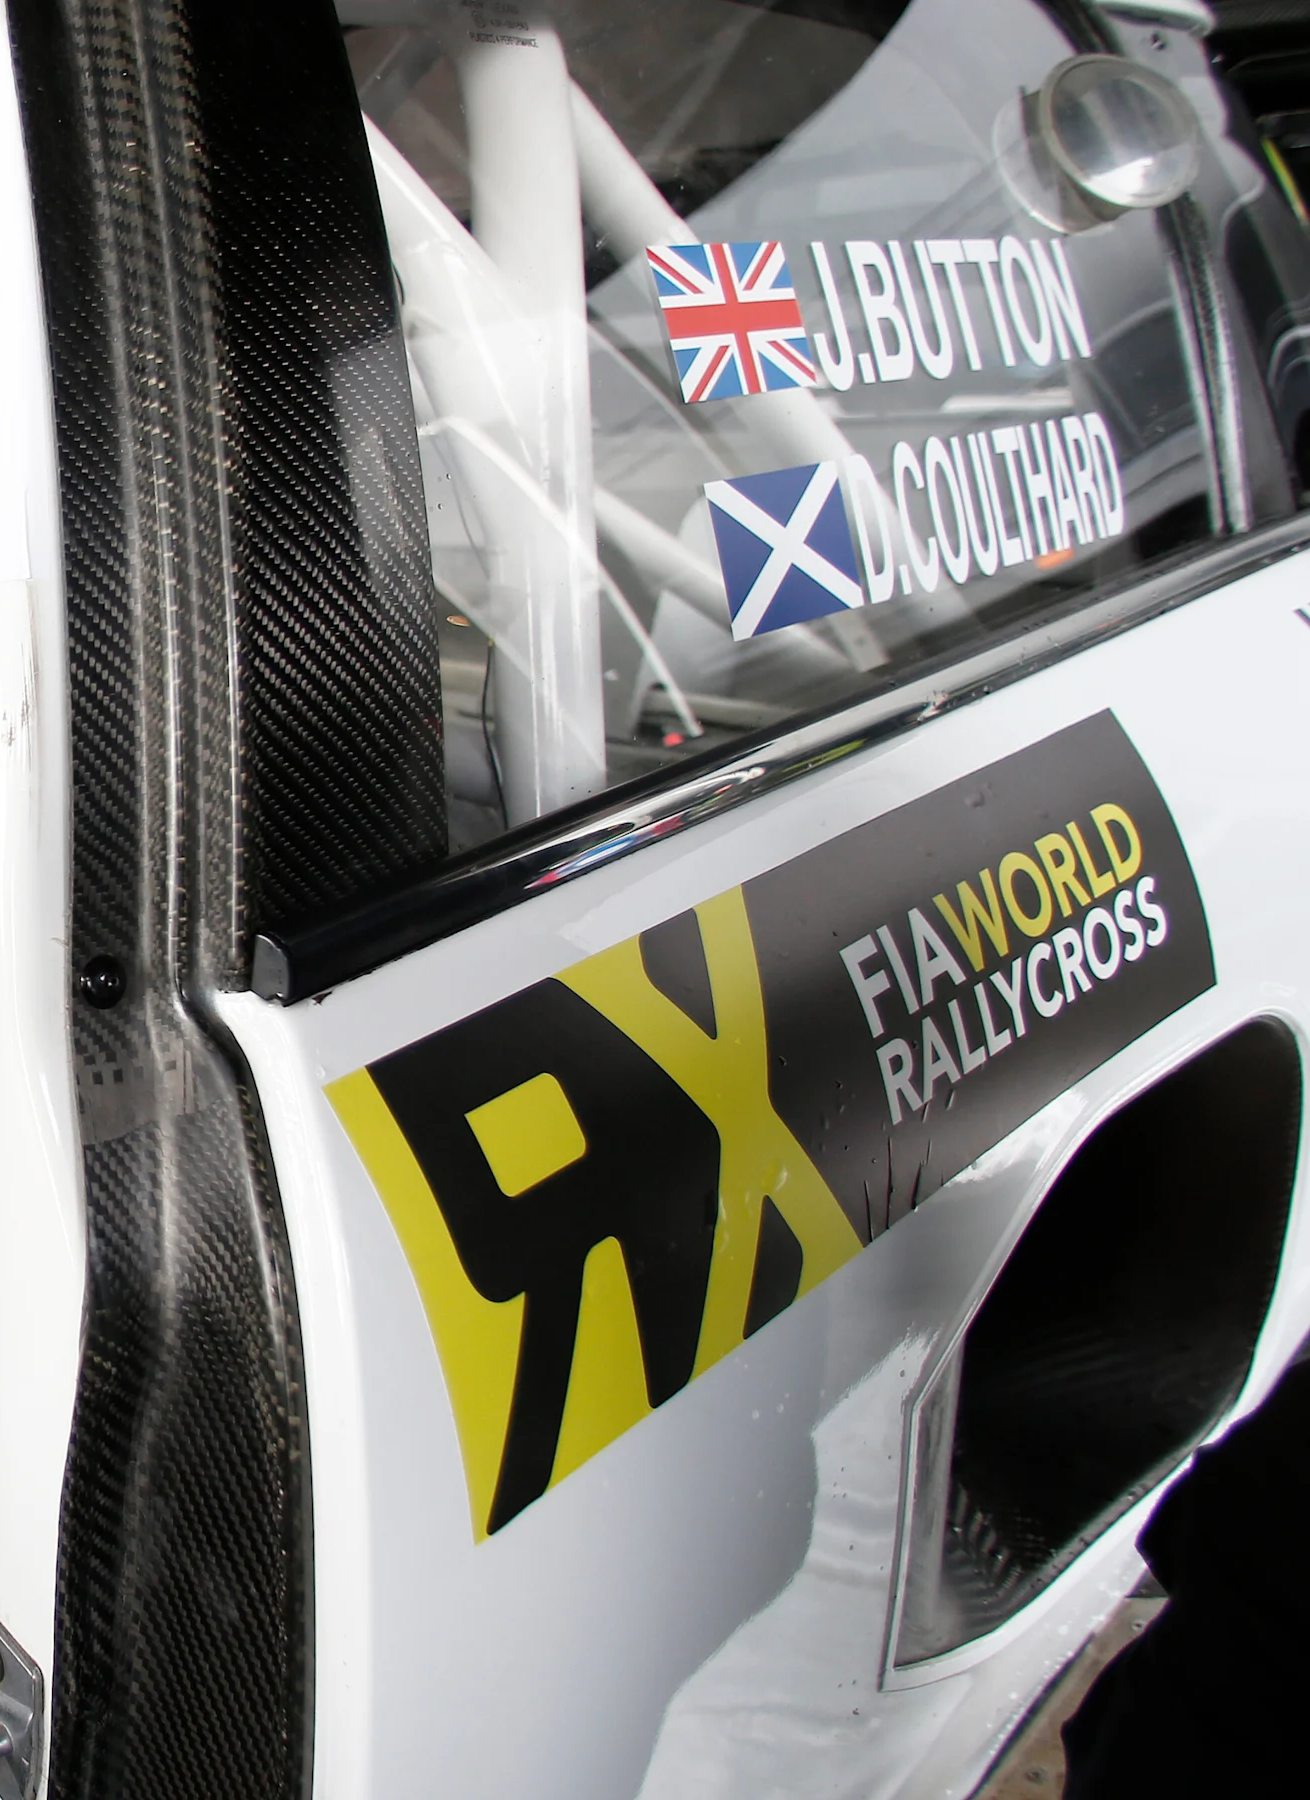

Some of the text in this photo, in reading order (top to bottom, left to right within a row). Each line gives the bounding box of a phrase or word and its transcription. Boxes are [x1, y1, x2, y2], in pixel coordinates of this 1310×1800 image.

[810, 235, 1091, 391] J.BUTTON
[845, 412, 1124, 604] D.COULTHARD
[876, 876, 1168, 1126] RALLYCROSS
